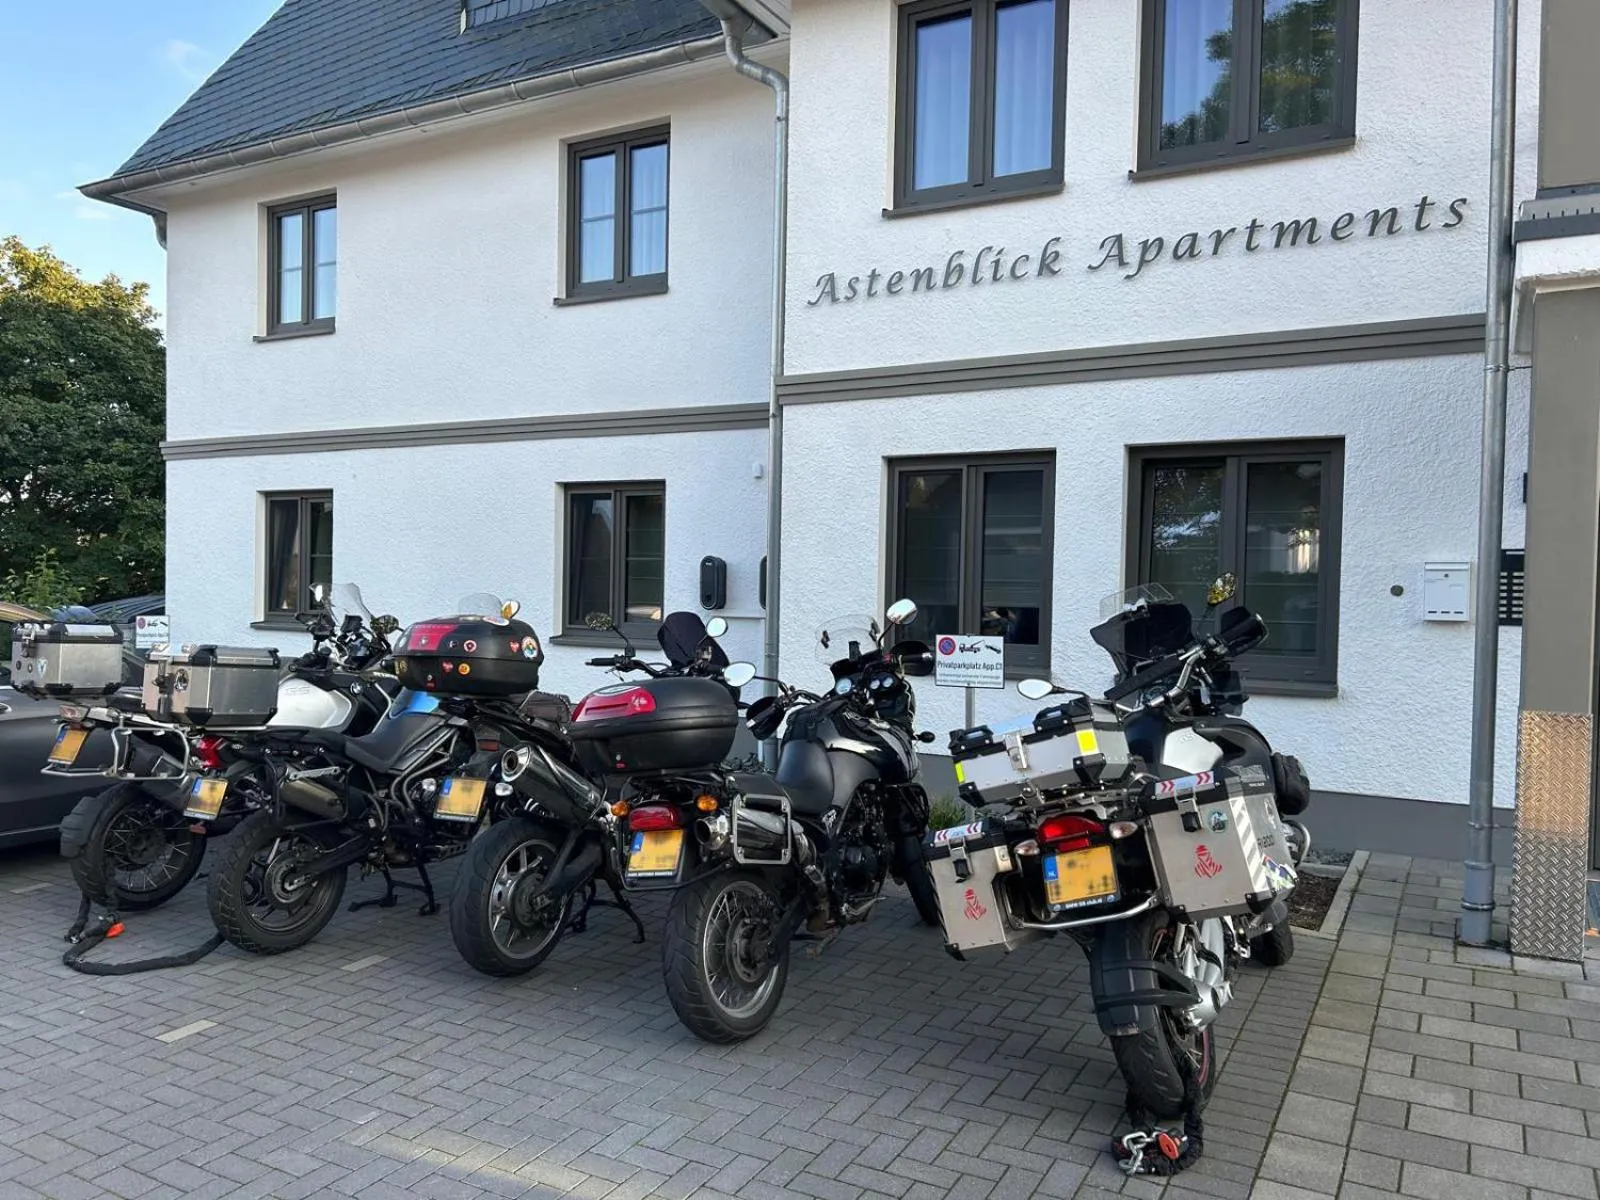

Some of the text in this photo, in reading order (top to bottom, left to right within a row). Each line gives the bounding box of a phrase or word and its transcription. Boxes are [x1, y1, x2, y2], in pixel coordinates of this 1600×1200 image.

[808, 195, 1467, 306] Astenblick Apartments
[938, 661, 982, 670] Privatparkplatz
